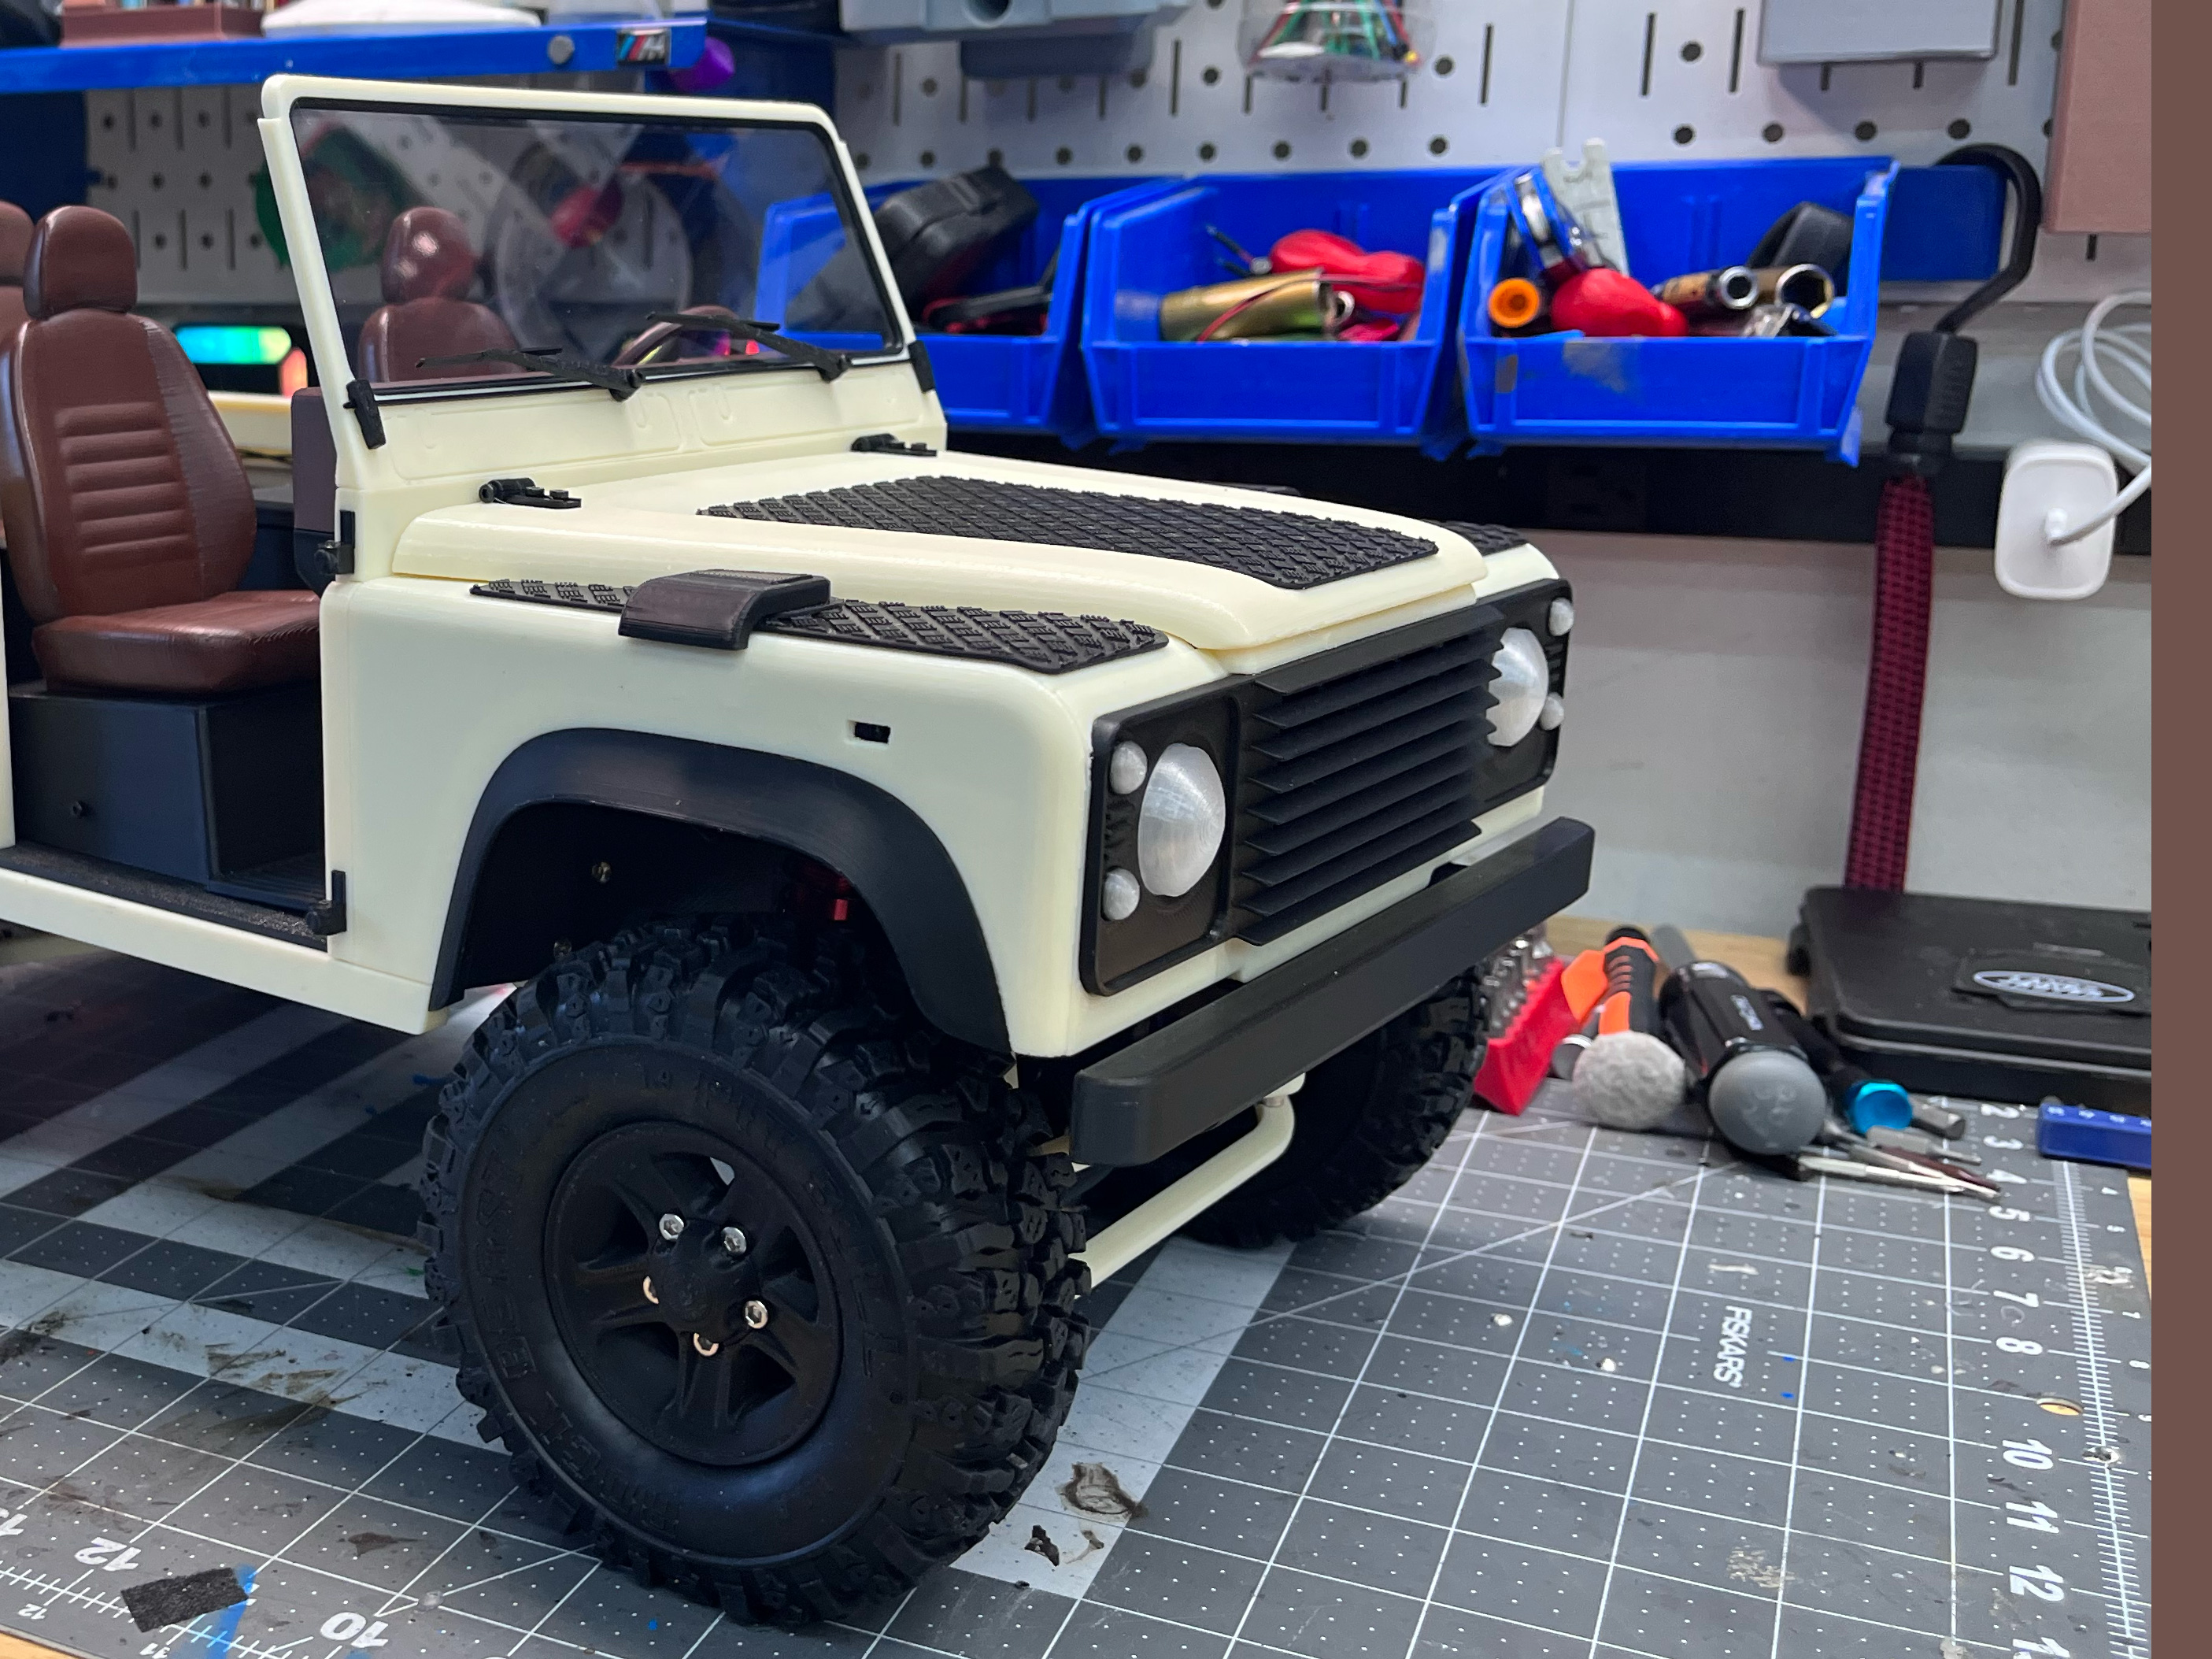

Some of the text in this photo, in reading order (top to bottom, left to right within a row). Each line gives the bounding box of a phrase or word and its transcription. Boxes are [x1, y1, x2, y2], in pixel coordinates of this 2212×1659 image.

[1981, 1104, 2020, 1119] 2
[1983, 1135, 2024, 1150] 3
[1986, 1168, 2027, 1184] 4
[1988, 1205, 2030, 1221] 5
[1991, 1246, 2034, 1262] 6
[1993, 1290, 2039, 1307] 7
[1713, 1305, 1752, 1388] FISKARS
[1996, 1336, 2044, 1355] 8
[2002, 1438, 2053, 1471] 10
[2005, 1501, 2060, 1534] 11
[74, 1536, 142, 1572] 12
[2009, 1565, 2065, 1602] 12
[17, 1603, 48, 1620] 12
[320, 1612, 389, 1648] 10
